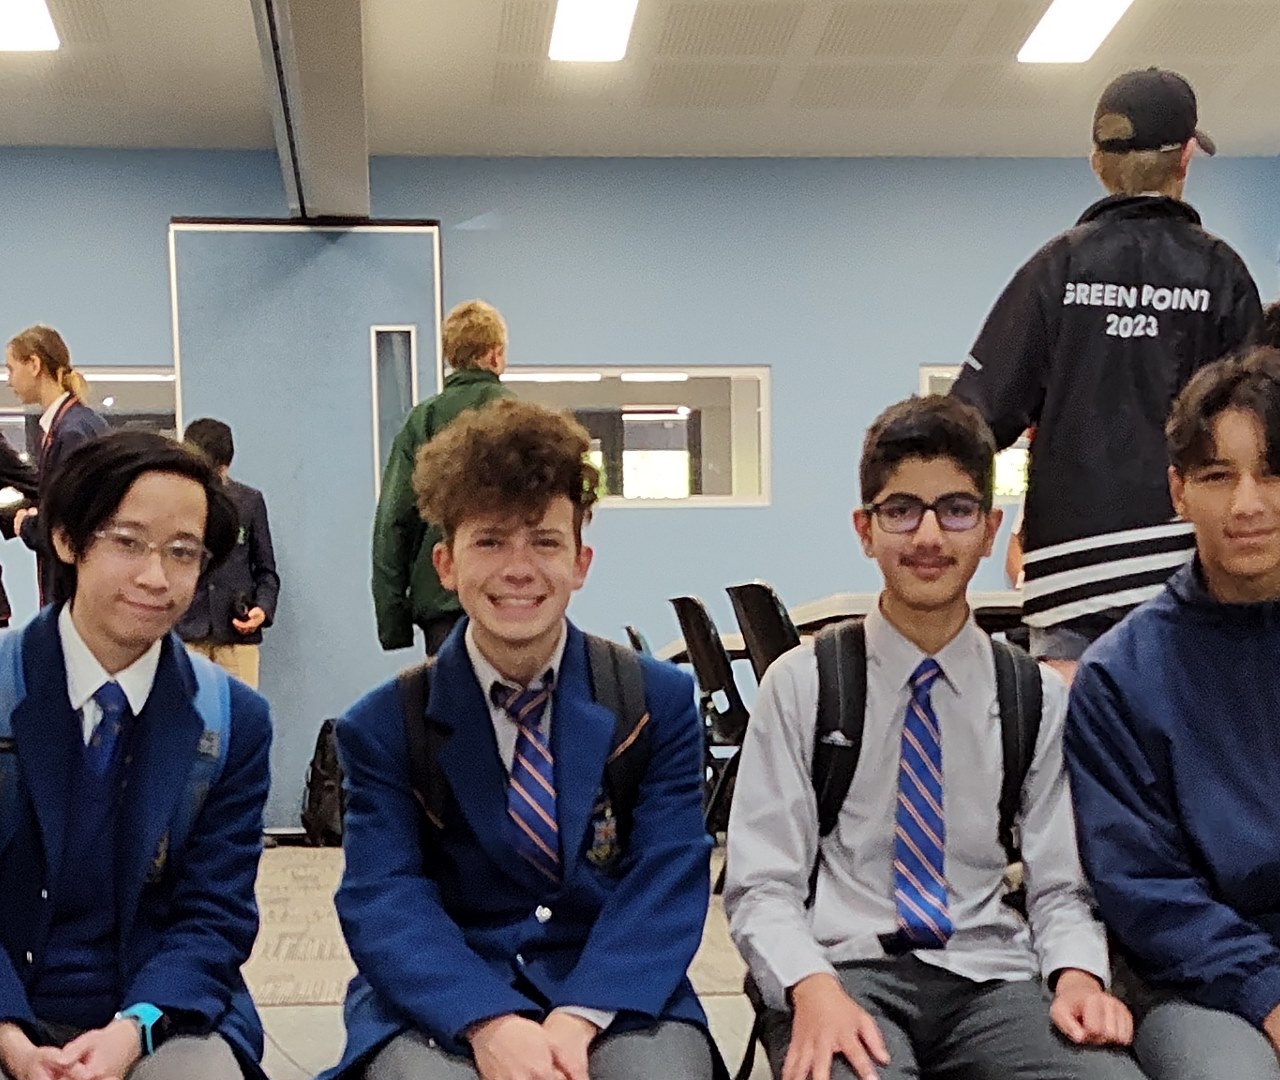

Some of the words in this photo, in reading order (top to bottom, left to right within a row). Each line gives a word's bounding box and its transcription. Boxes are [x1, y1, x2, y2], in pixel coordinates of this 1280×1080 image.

[1063, 282, 1138, 309] GREEN
[1141, 284, 1211, 312] POINT
[1106, 313, 1159, 338] 2023
